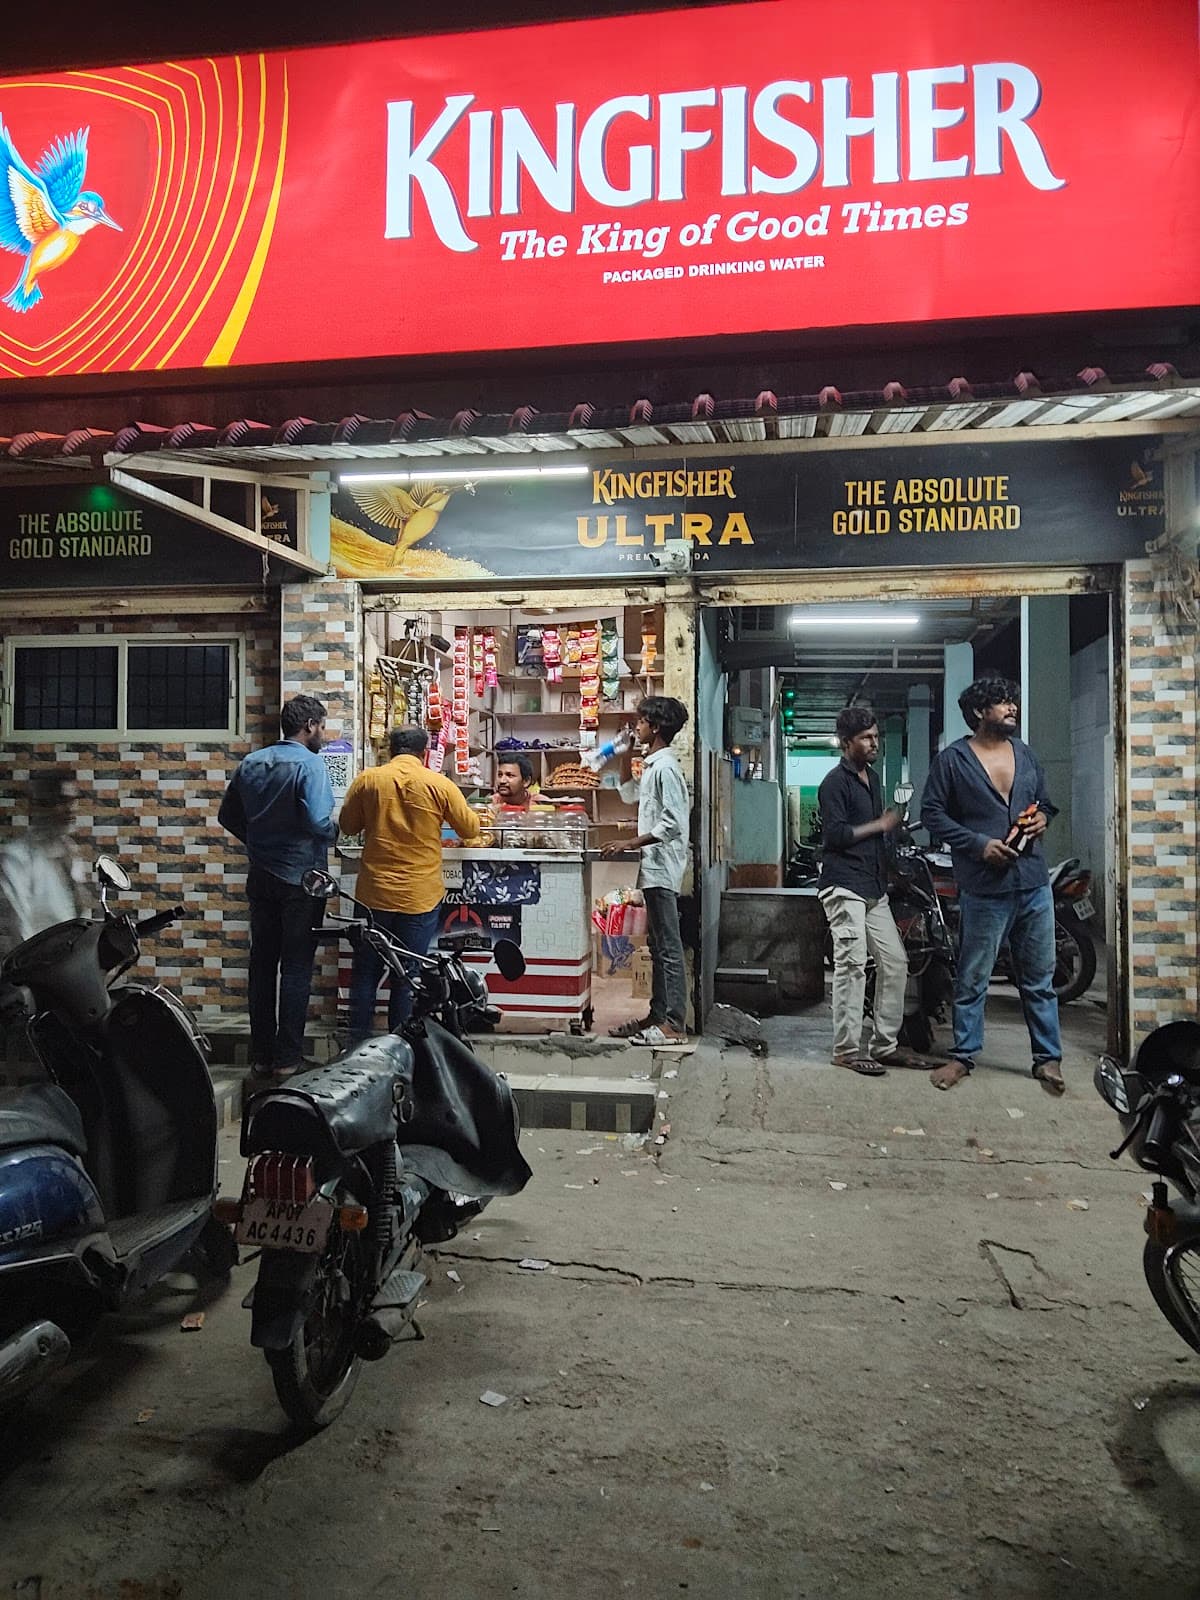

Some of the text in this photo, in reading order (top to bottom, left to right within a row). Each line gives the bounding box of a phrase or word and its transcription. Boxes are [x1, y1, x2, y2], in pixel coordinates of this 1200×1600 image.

[384, 62, 1069, 253] KINGFISHER
[499, 200, 970, 261] The King of Good Times
[602, 255, 826, 284] PACKAGED DRINKING WATER
[592, 467, 737, 506] KINGFISHER
[845, 475, 1010, 506] THE ABSOLUTE
[18, 509, 144, 535] THE ABSOLUTE
[577, 512, 755, 548] ULTRA
[832, 504, 1022, 536] GOLD STANDARD
[9, 534, 153, 560] GOLD STANDARD
[618, 553, 651, 561] PREM
[443, 870, 462, 879] TOBAC
